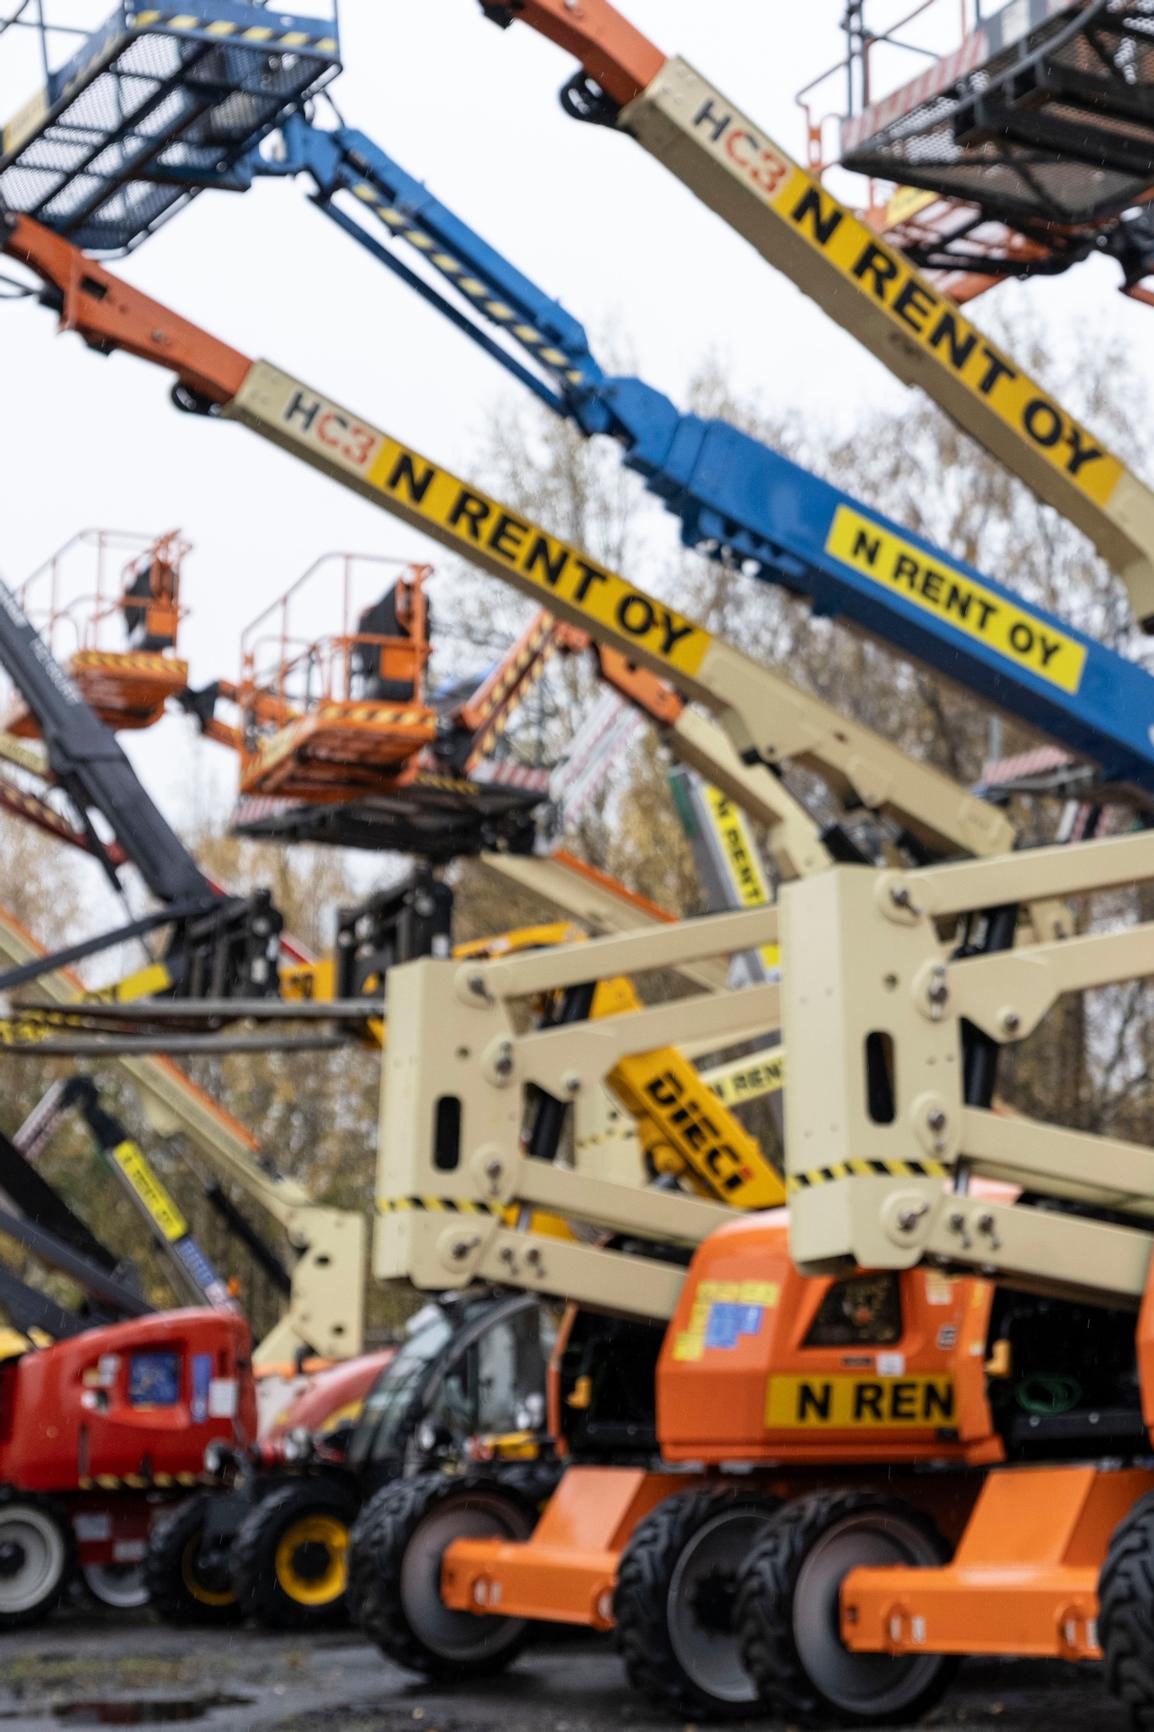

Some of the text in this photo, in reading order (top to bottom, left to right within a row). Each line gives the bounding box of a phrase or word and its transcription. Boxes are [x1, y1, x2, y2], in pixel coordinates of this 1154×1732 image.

[693, 100, 789, 194] HC3
[791, 186, 1103, 476] N RENT OY
[285, 393, 377, 466] HC3
[387, 454, 693, 656] N RENT OY
[852, 529, 1061, 667] N RENT OY
[796, 1382, 833, 1421] N
